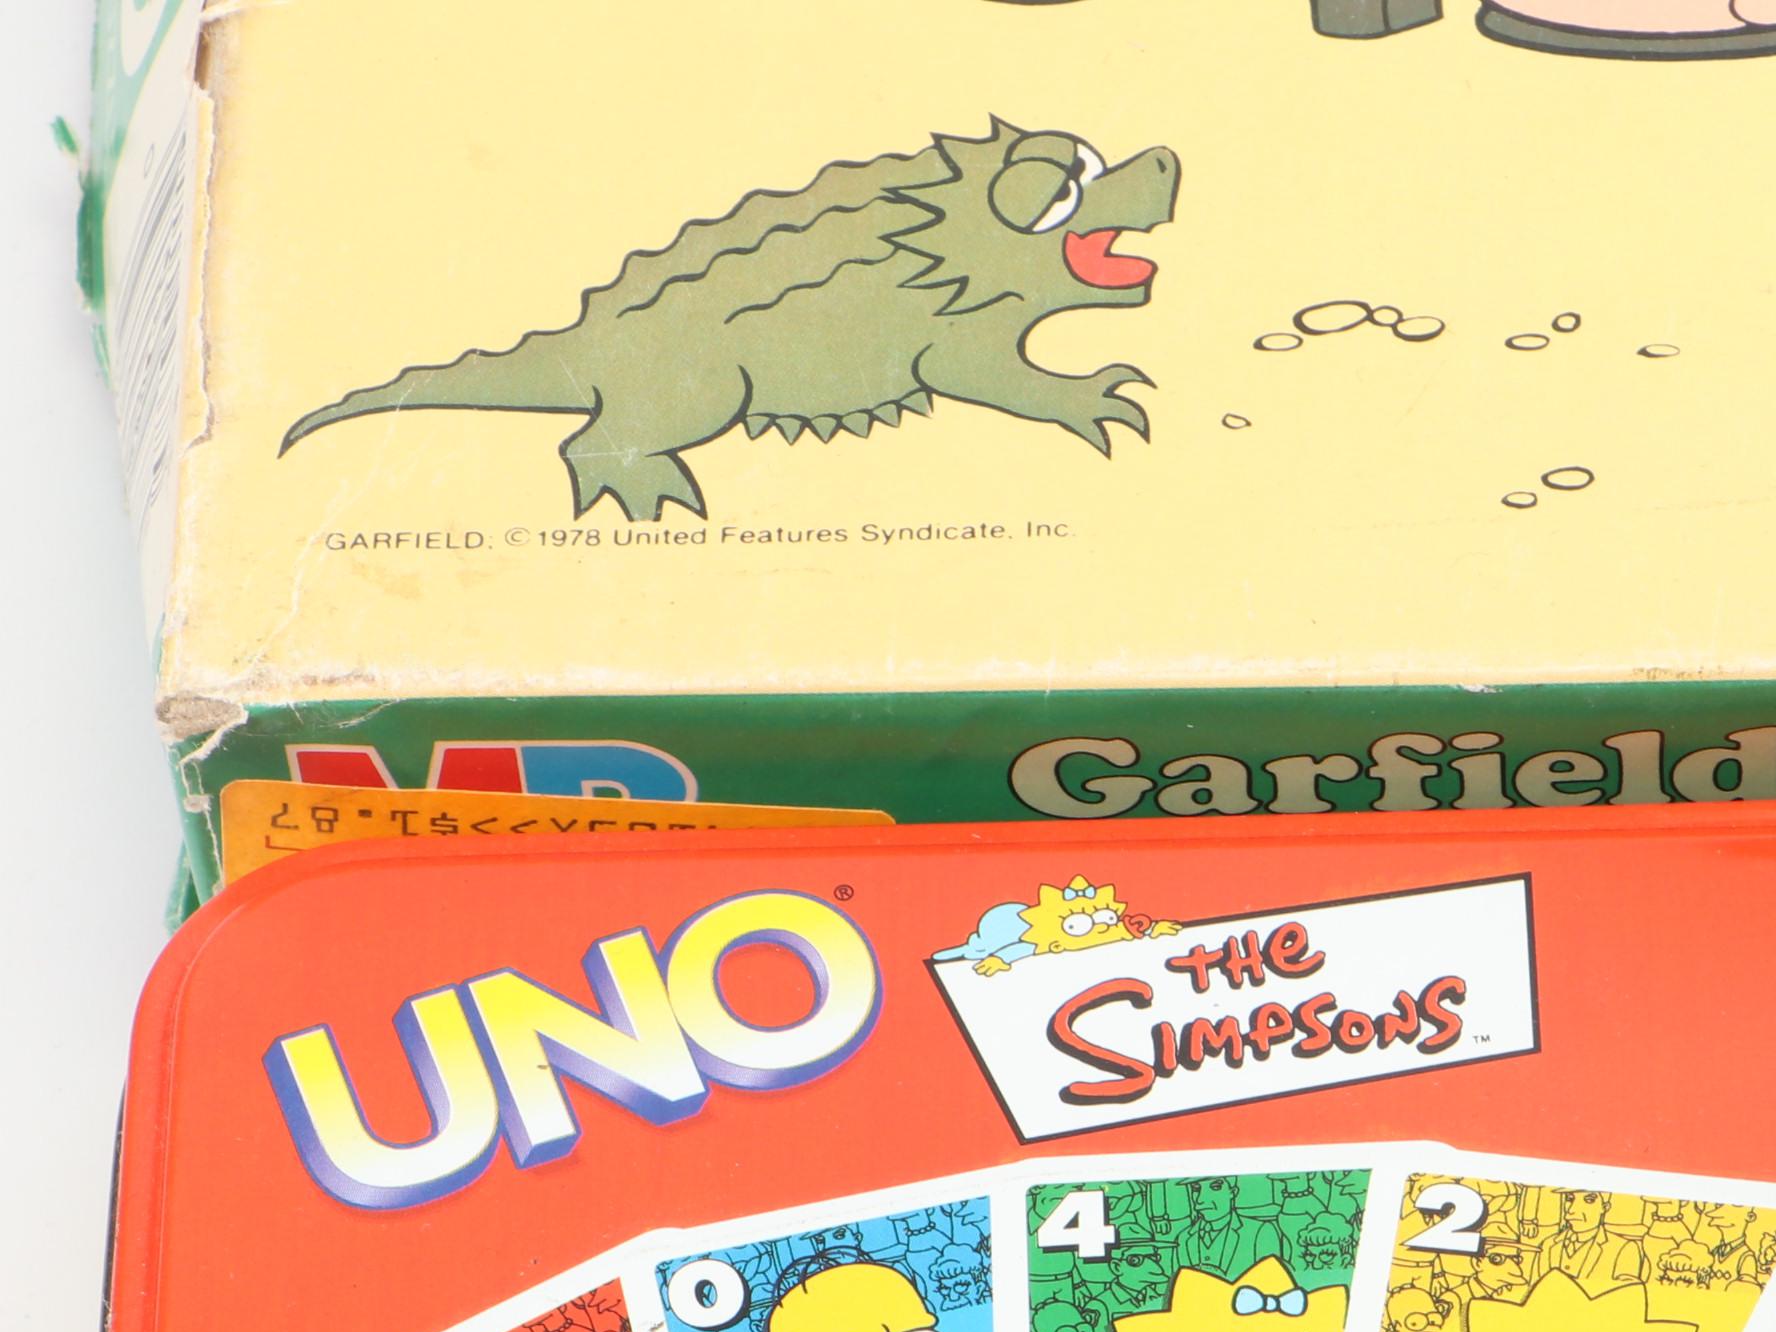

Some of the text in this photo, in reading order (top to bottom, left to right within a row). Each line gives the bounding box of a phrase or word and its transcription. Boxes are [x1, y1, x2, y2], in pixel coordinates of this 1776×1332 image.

[613, 527, 707, 546] United
[720, 527, 849, 544] Features
[262, 888, 884, 1210] UNO
[1035, 1189, 1118, 1264] 4
[1400, 1183, 1487, 1258] 2
